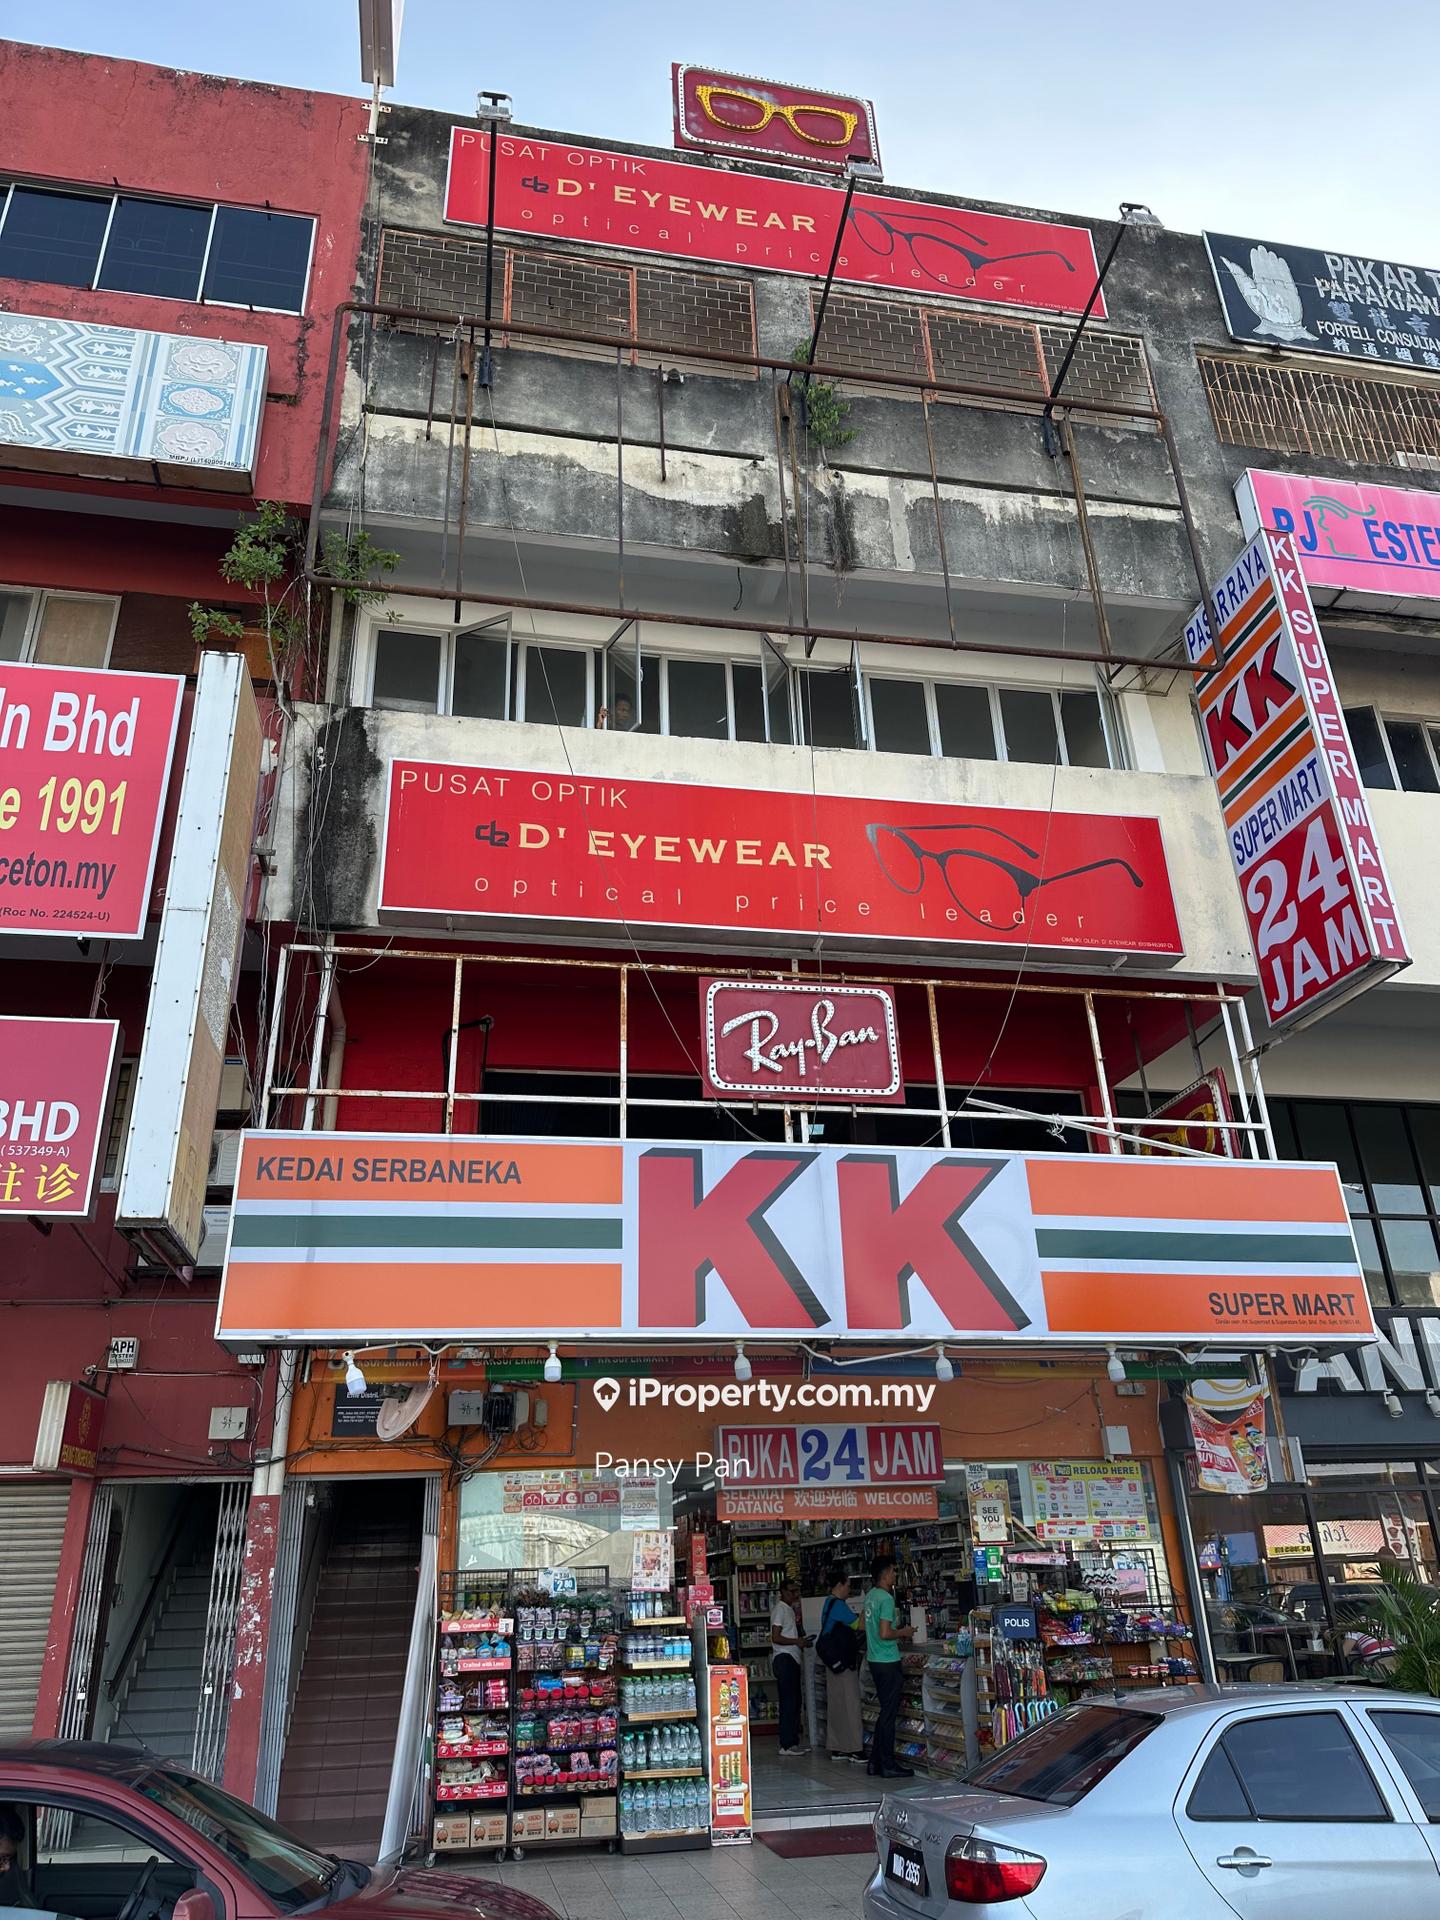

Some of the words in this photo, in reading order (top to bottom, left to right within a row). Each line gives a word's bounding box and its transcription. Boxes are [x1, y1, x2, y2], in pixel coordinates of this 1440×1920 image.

[567, 151, 648, 175] OPTIK
[556, 179, 596, 197] D'
[613, 186, 817, 234] EYEWEAR
[521, 208, 693, 244] optical
[736, 241, 849, 268] price
[890, 263, 1026, 294] leader
[1323, 253, 1423, 296] PAKAR
[1316, 319, 1375, 342] FORTELL
[43, 691, 140, 757] Bhd
[1204, 632, 1298, 774] KK
[400, 770, 511, 799] PUSAT
[531, 781, 629, 809] OPTIK
[1291, 607, 1354, 780] SUPER
[1340, 795, 1396, 952] MART
[38, 776, 127, 835] 1991
[1231, 808, 1284, 867] SUPER
[1279, 756, 1323, 833] MART
[518, 822, 567, 850] D'
[587, 830, 833, 870] EYEWEAR
[474, 875, 683, 906] optical
[735, 892, 870, 916] price
[920, 902, 1085, 929] leader
[1246, 814, 1350, 961] 24
[29, 908, 49, 919] No.
[52, 909, 111, 922] 224524-U)
[1270, 903, 1369, 1013] JAM
[720, 999, 880, 1077] Ray-Ban
[256, 1156, 343, 1182] KEDAI
[351, 1158, 522, 1185] SERBANEKA
[638, 1147, 1033, 1331] KK
[1208, 1291, 1288, 1317] SUPER
[1291, 1293, 1355, 1316] MART
[112, 1340, 135, 1353] APH
[727, 1433, 795, 1480] BUKA
[801, 1428, 865, 1481] 24
[873, 1430, 937, 1477] JAM
[1073, 1466, 1109, 1475] RELOAD
[725, 1500, 785, 1514] DATANG
[793, 1489, 858, 1507] 欢迎光临
[864, 1491, 934, 1505] WELCOME
[982, 1506, 998, 1514] SEE
[982, 1515, 1000, 1523] YOU
[1004, 1618, 1030, 1628] POLIS
